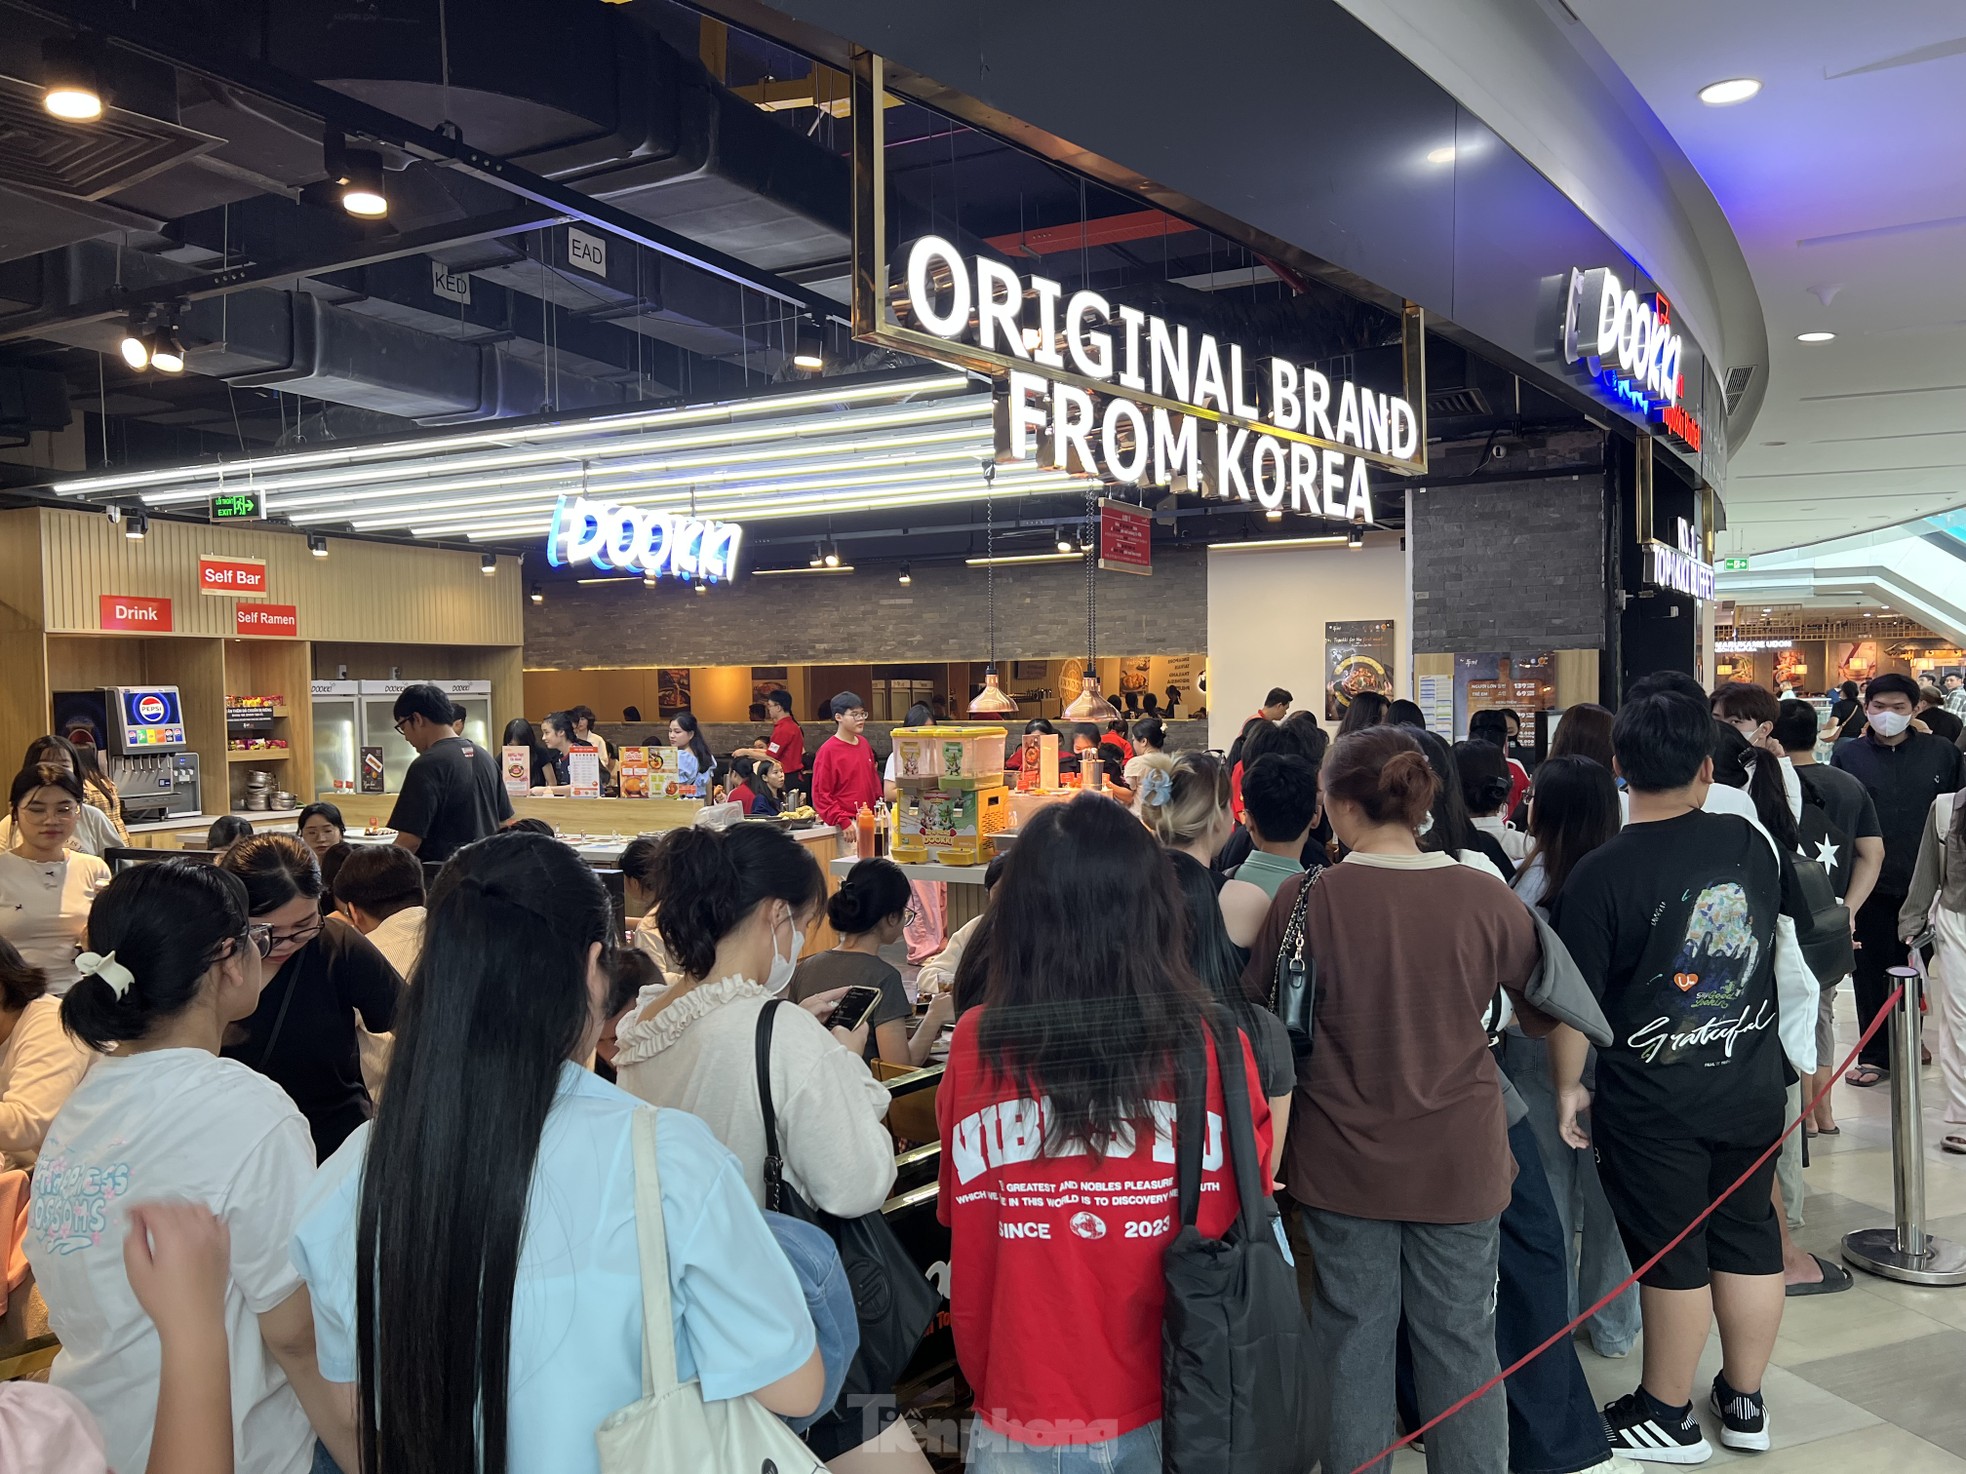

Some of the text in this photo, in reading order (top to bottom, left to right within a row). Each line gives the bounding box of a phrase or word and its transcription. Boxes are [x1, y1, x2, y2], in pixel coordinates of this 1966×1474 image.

[571, 237, 604, 266] EAD
[434, 271, 468, 296] KED
[907, 234, 1417, 460] ORIGINAL BRAND
[1597, 267, 1682, 409] DOOKKI
[1009, 369, 1374, 524] FROM KOREA
[217, 508, 232, 517] EXIT
[565, 496, 743, 586] DOOKKI
[205, 568, 261, 585] Self Bar
[115, 604, 158, 621] Drink
[237, 611, 295, 626] Self Ramen
[1627, 999, 1776, 1064] Grateful
[1006, 1182, 1056, 1193] GREATEST
[1059, 1180, 1078, 1192] AND
[1080, 1180, 1122, 1192] NOBLES
[1124, 1177, 1174, 1190] PLEASURE
[955, 1190, 987, 1205] WHICH
[1008, 1197, 1019, 1207] IN
[1022, 1197, 1044, 1206] THIS
[1046, 1194, 1079, 1208] WORLD
[1081, 1196, 1091, 1205] IS
[1094, 1197, 1109, 1206] TO
[1111, 1192, 1168, 1206] DISCOVERY
[1124, 1214, 1170, 1239] 2023
